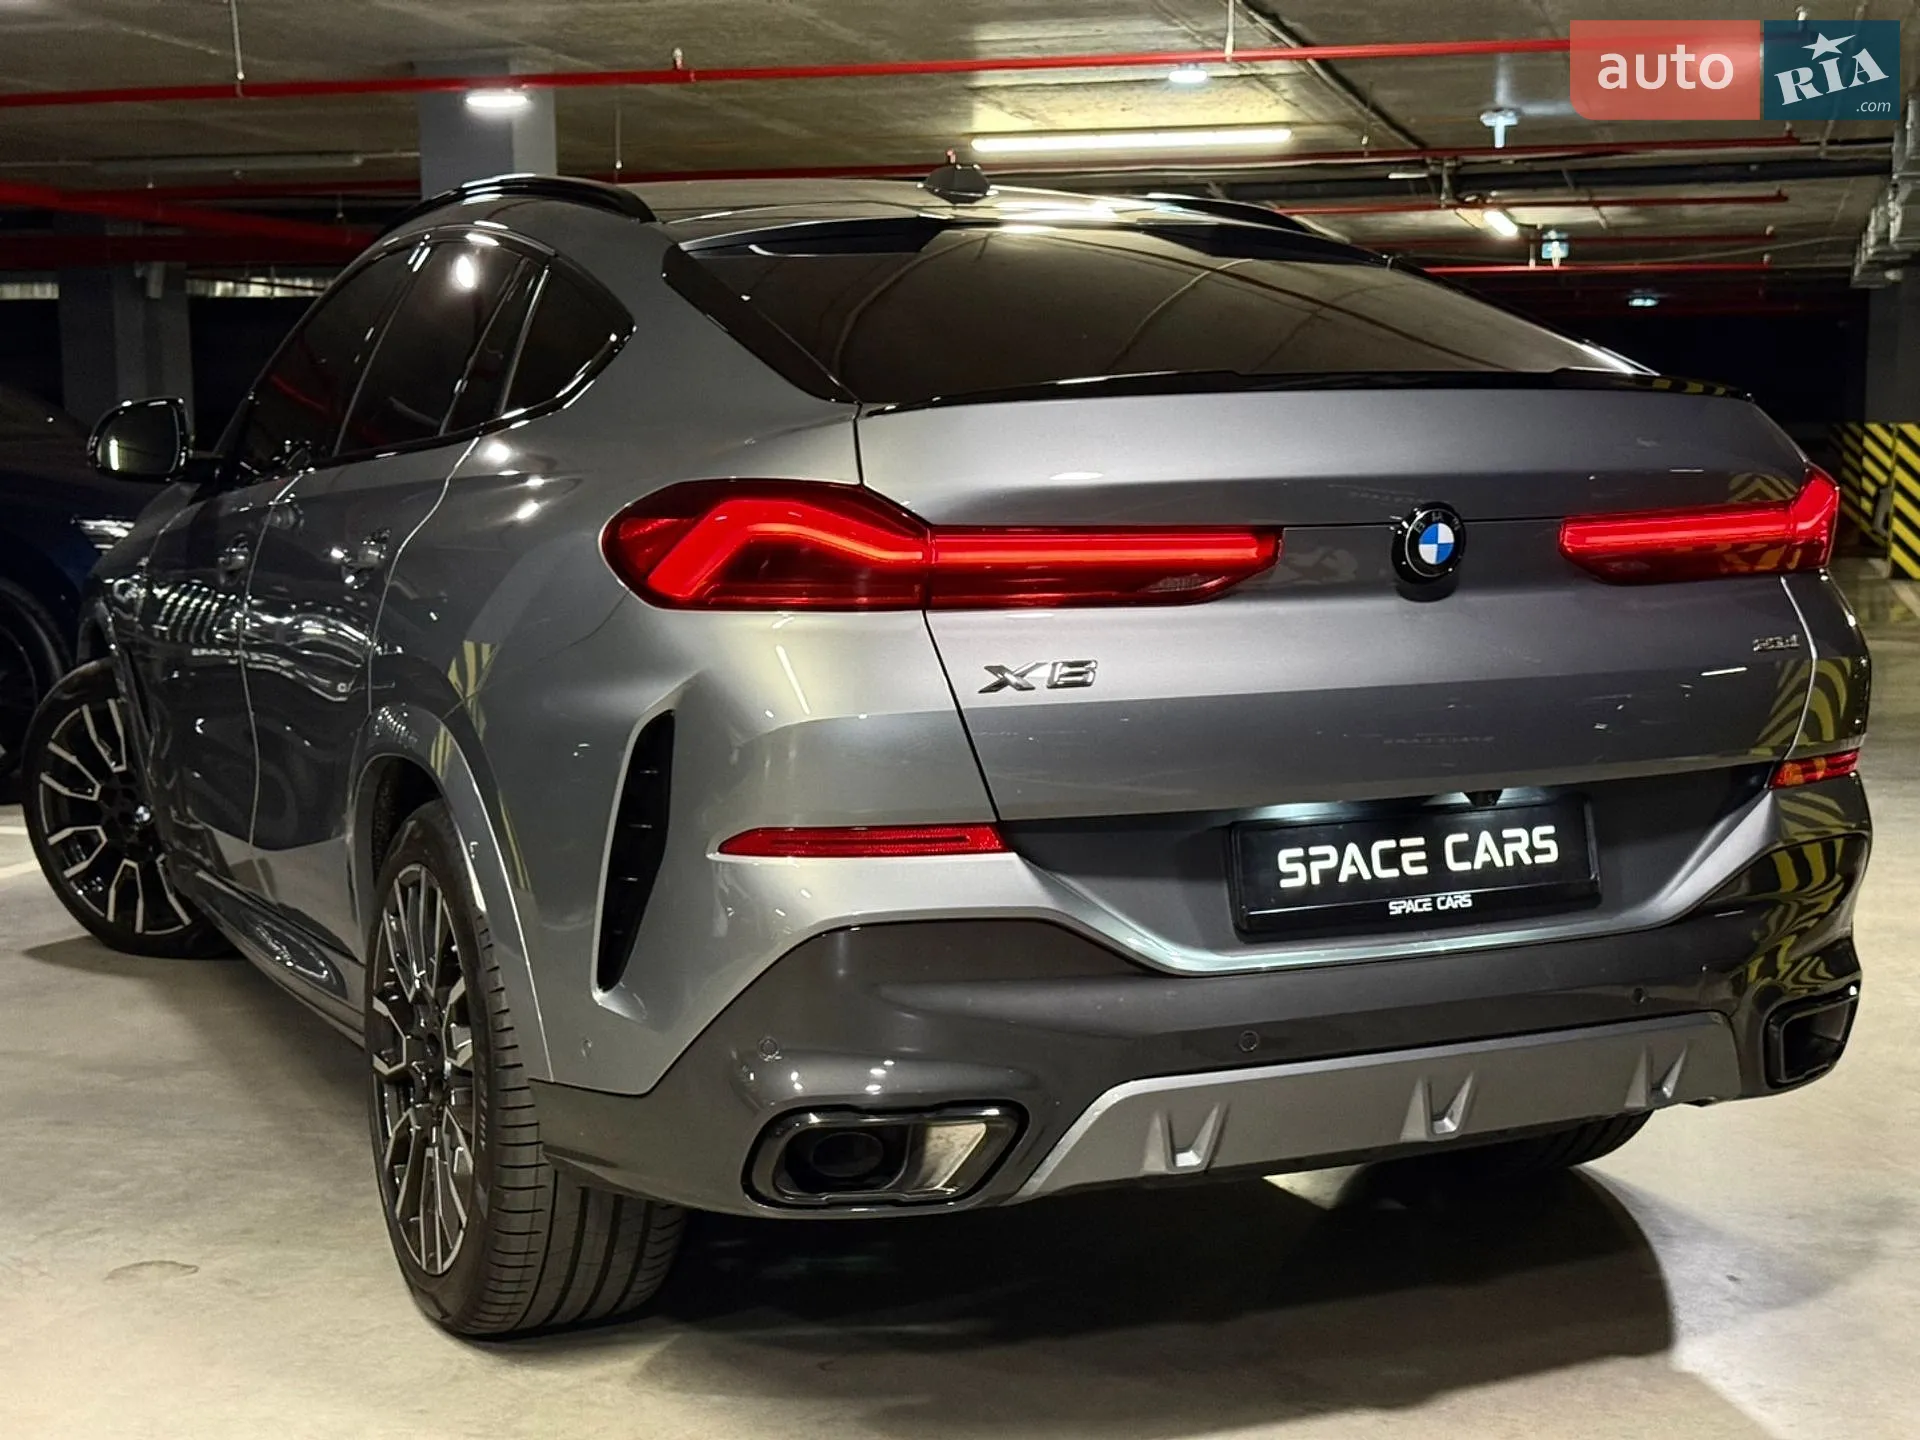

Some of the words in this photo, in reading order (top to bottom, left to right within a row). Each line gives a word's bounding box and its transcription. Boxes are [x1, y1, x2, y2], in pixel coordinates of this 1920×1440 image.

[978, 659, 1098, 693] X6
[1277, 836, 1429, 888] SPACE
[1445, 825, 1559, 872] CARS
[1388, 898, 1433, 915] SPACE
[1436, 894, 1473, 910] CARS
